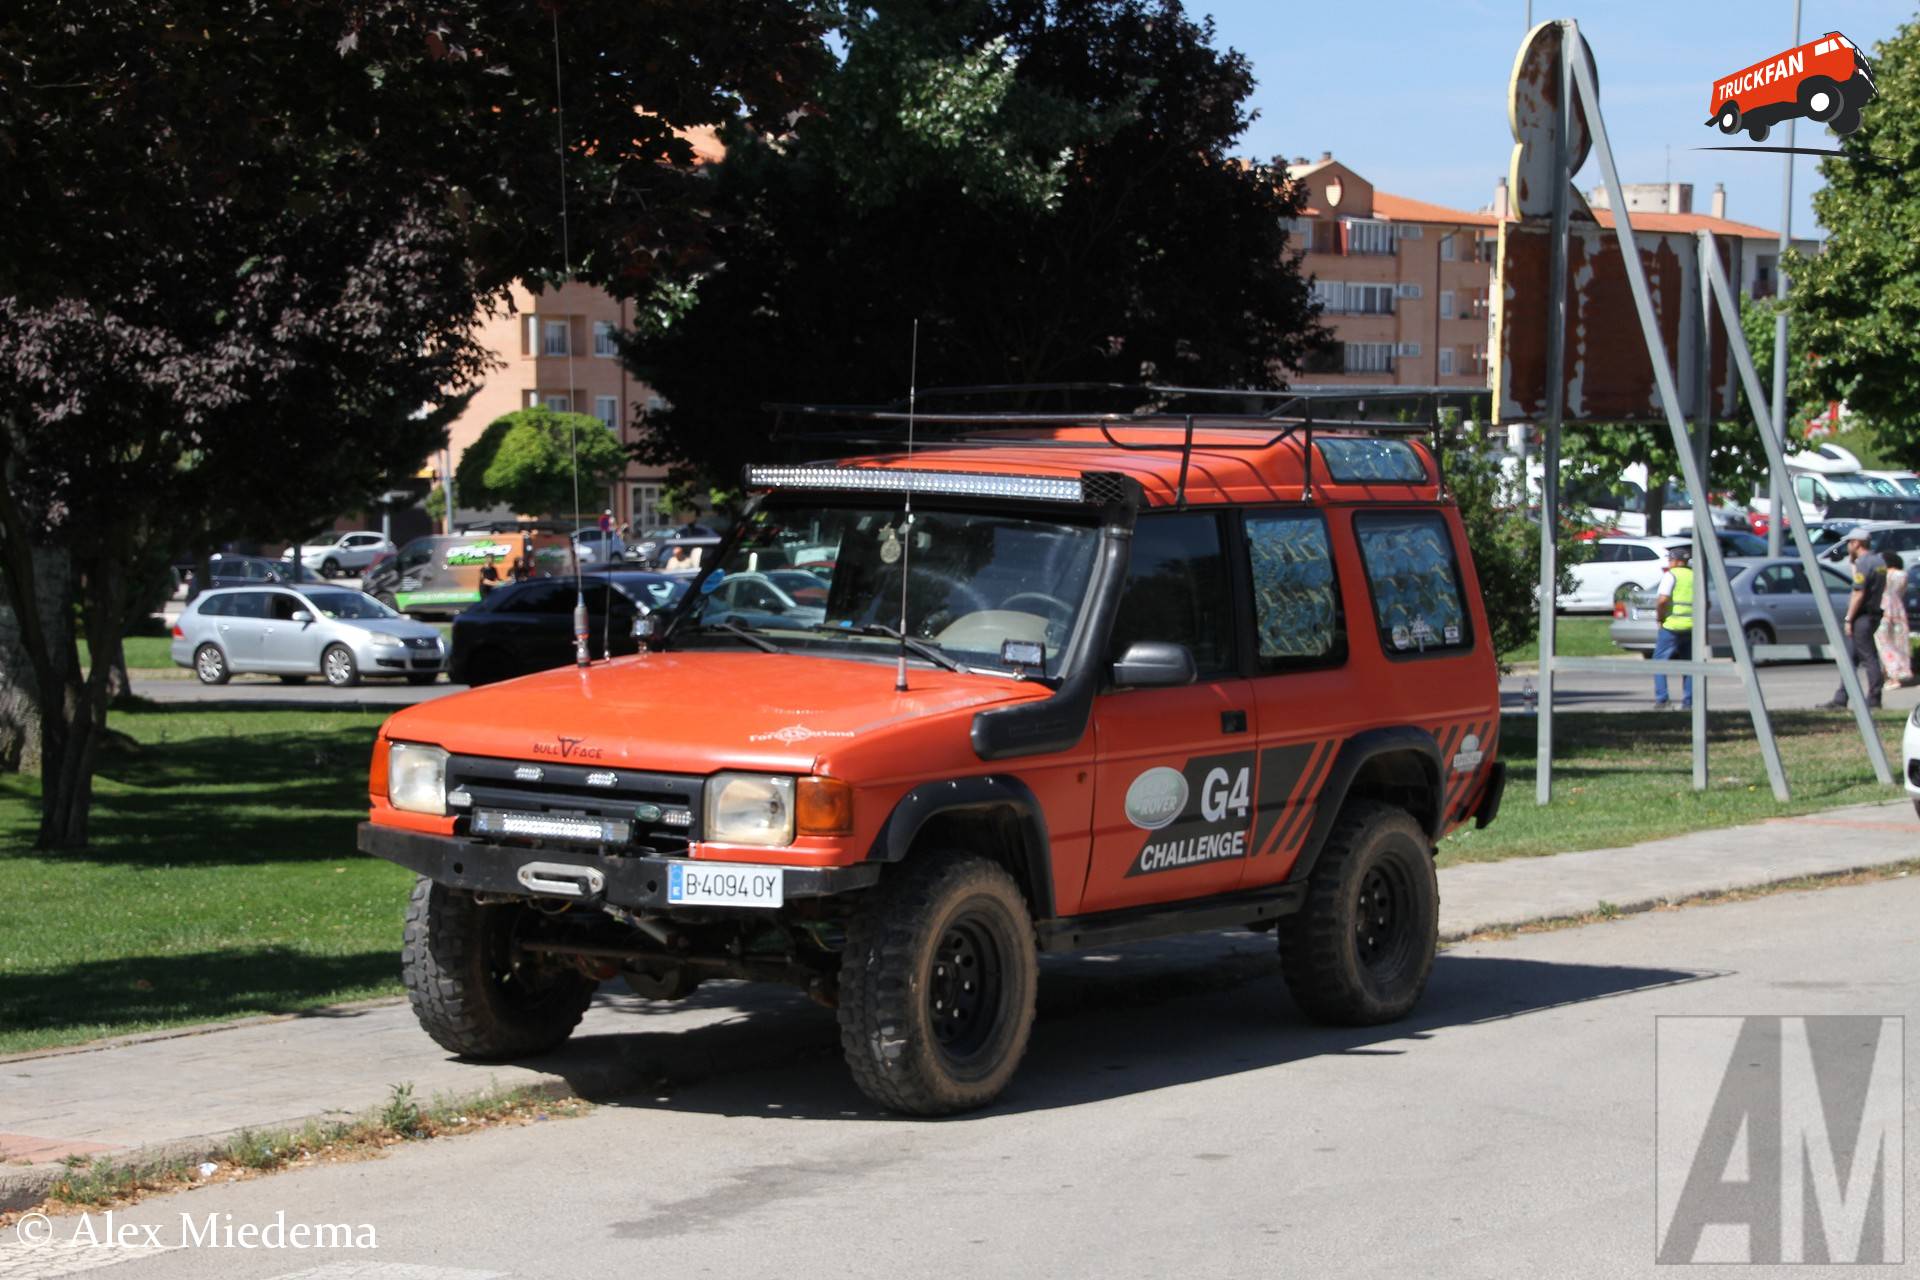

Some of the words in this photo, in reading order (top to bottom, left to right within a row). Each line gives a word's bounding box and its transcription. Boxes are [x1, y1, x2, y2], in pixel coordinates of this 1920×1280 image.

[533, 743, 559, 755] BULL
[573, 746, 604, 759] FACE
[1200, 766, 1250, 823] G4
[1140, 831, 1245, 871] CHALLENGE
